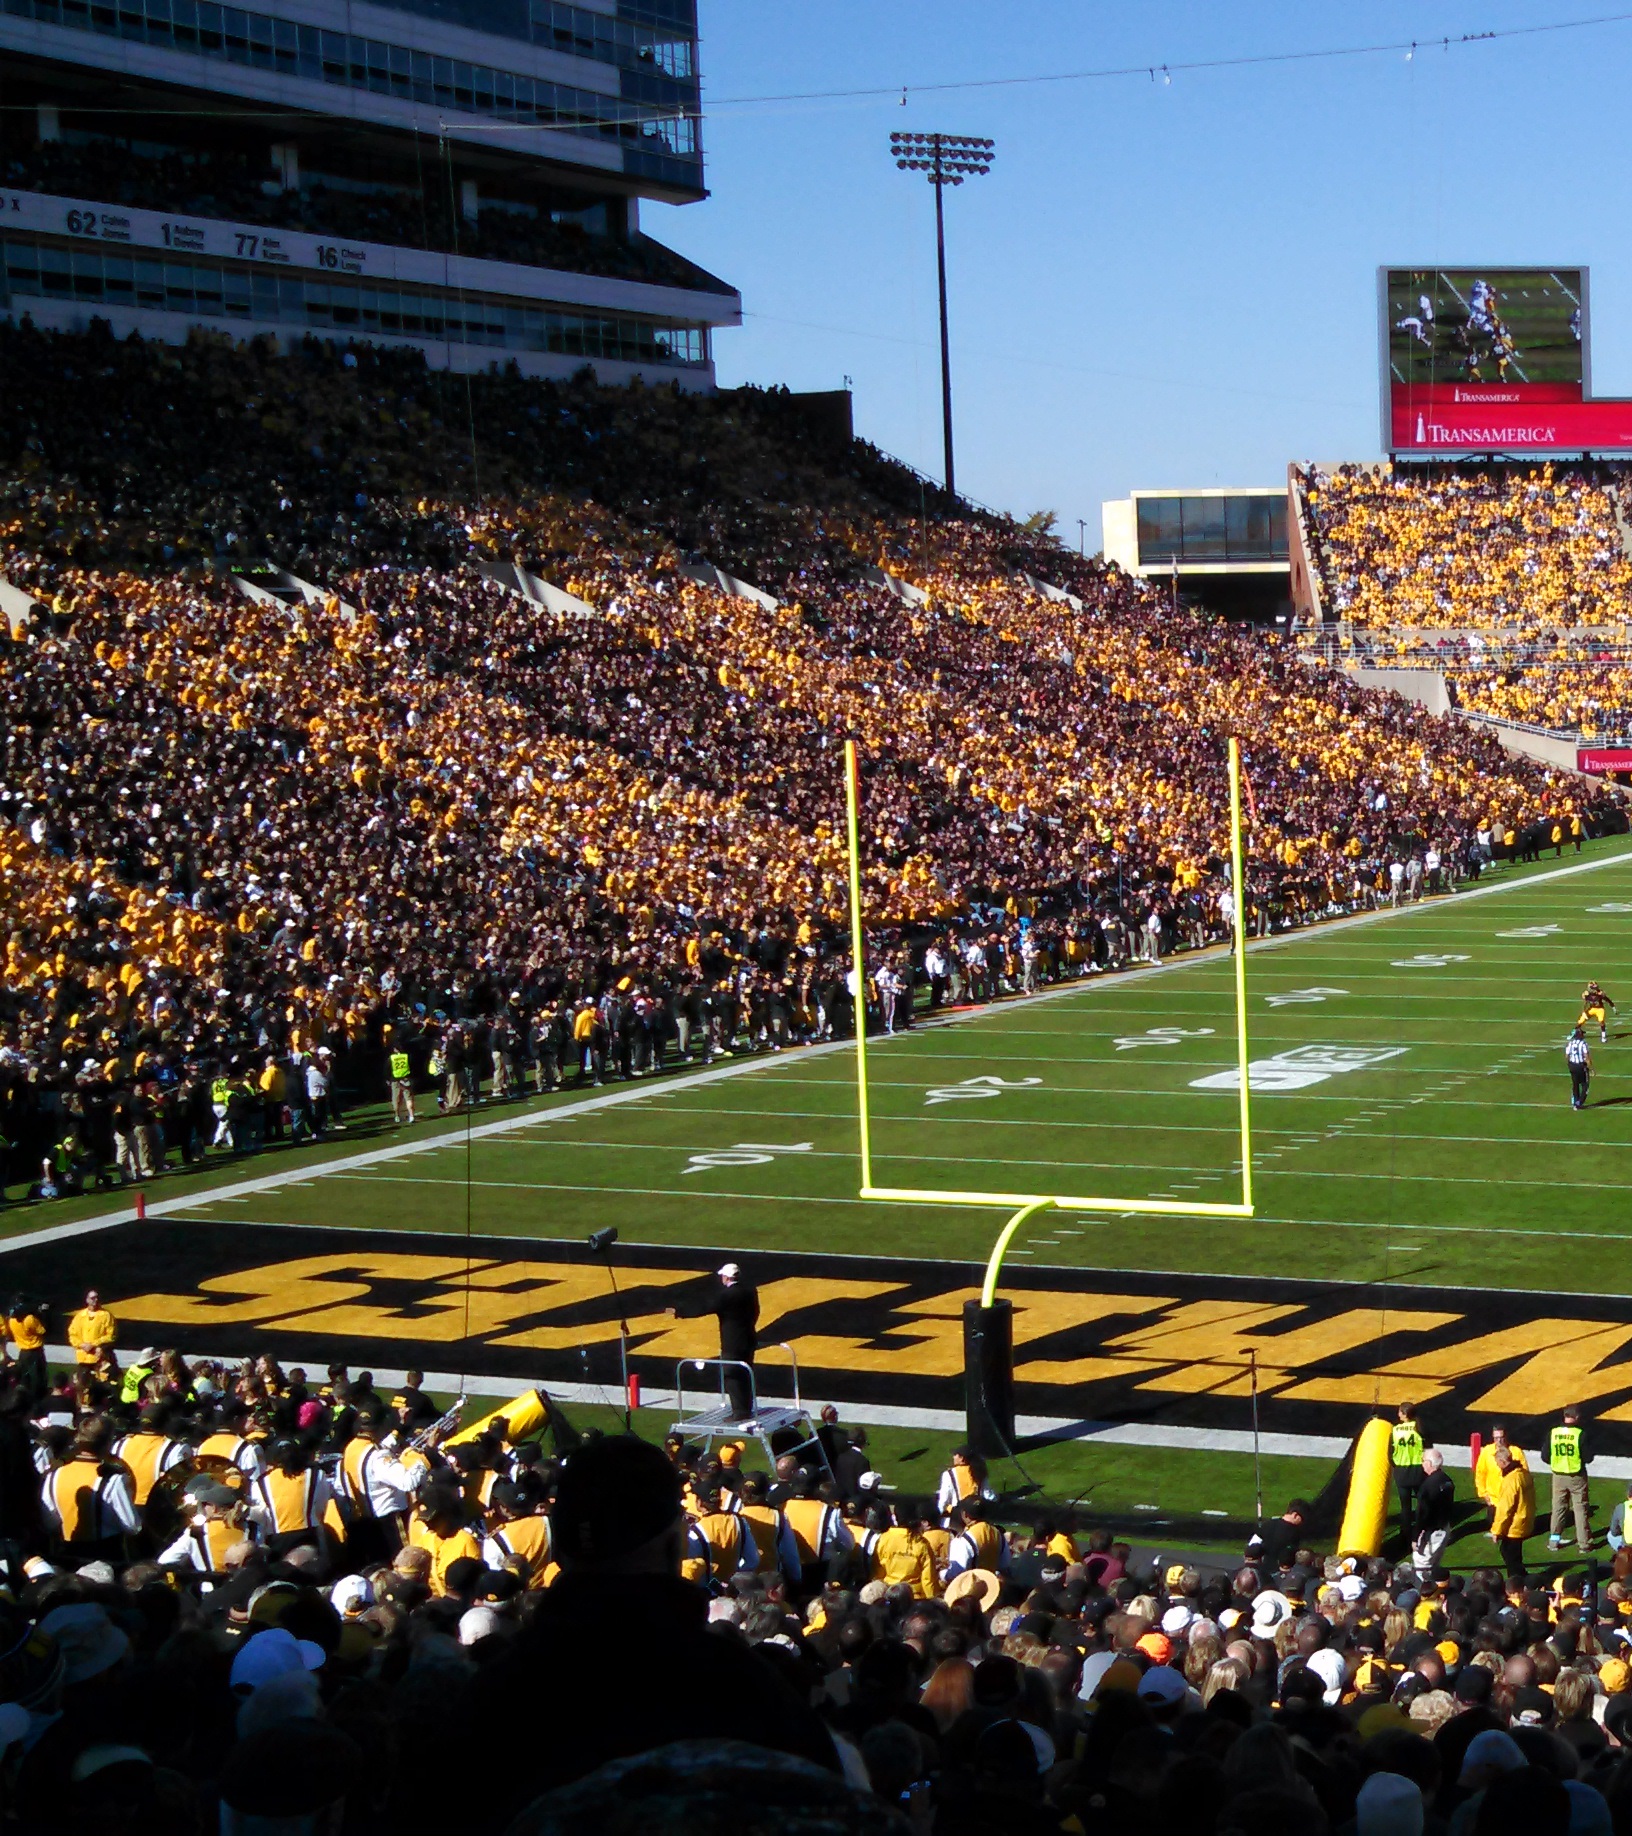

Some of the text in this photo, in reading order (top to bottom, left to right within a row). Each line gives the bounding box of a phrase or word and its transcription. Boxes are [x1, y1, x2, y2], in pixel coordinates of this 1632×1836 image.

[67, 209, 97, 237] 62
[161, 223, 171, 246] 1
[234, 233, 260, 258] 77
[316, 245, 338, 268] 16
[1461, 392, 1520, 403] TRANSAMERICA
[1427, 424, 1554, 443] TRANSAMERICA
[394, 1061, 406, 1070] 22
[924, 1075, 1044, 1100] 20
[687, 1141, 815, 1166] 10
[1397, 1433, 1416, 1448] 44
